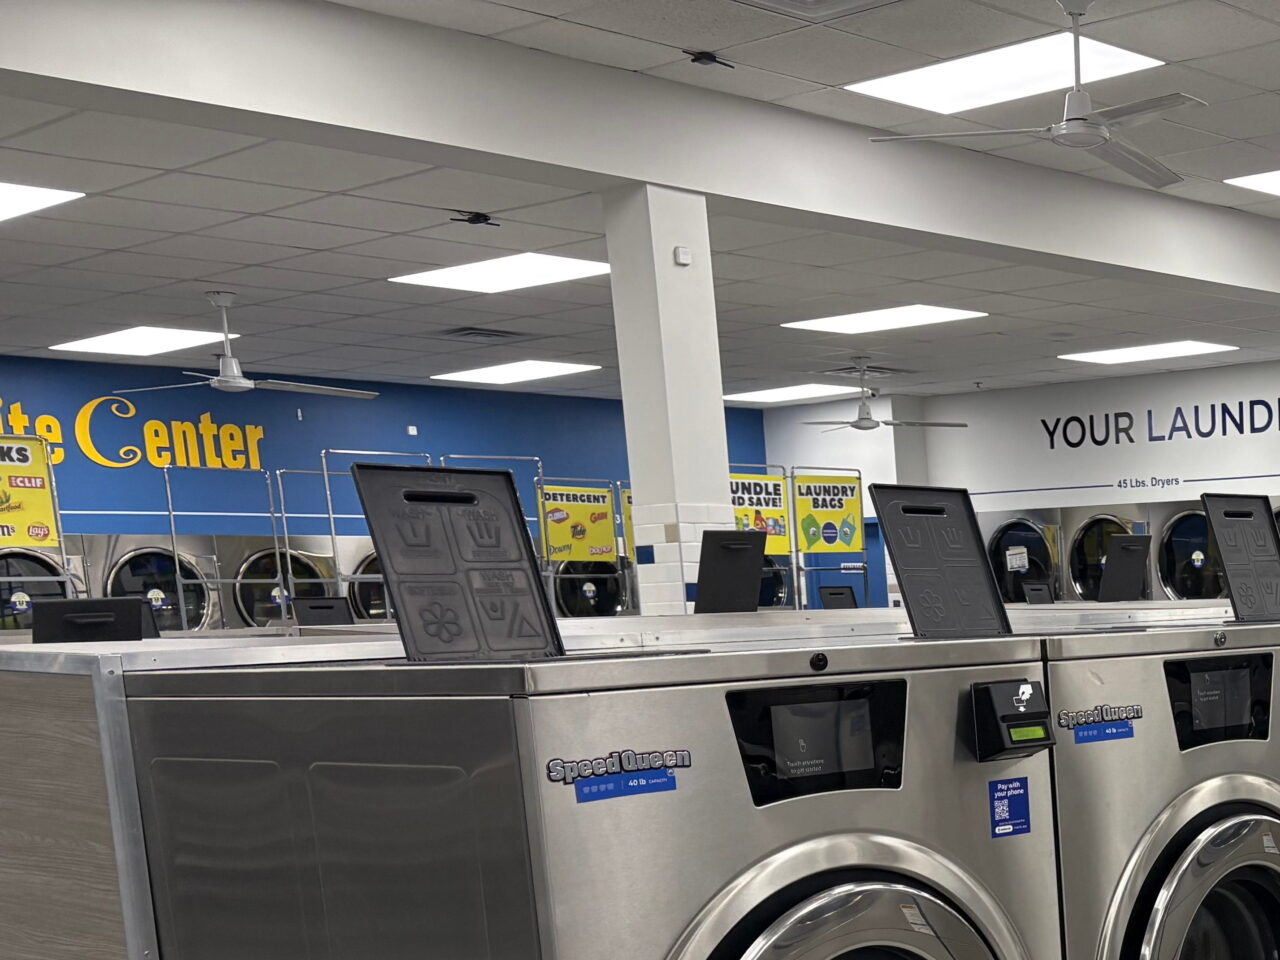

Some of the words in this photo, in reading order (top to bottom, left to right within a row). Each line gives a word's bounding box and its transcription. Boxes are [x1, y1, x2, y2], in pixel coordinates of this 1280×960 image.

[75, 396, 264, 470] Center
[1040, 411, 1135, 450] YOUR
[16, 477, 43, 488] CLIF
[1117, 478, 1128, 488] 45
[1130, 478, 1148, 488] Lbs.
[1151, 476, 1180, 488] Dryers
[730, 481, 782, 496] UNDLE
[798, 485, 856, 497] LAUNDRY
[544, 492, 607, 504] DETERGENT
[748, 496, 782, 507] SAVE!
[813, 498, 844, 509] BAGS
[1059, 706, 1102, 729] Speed
[1102, 705, 1142, 721] Queen
[548, 752, 621, 784] Speed
[621, 750, 691, 772] Queen
[628, 778, 637, 786] 40
[994, 791, 1006, 799] your
[1008, 789, 1024, 797] phone
